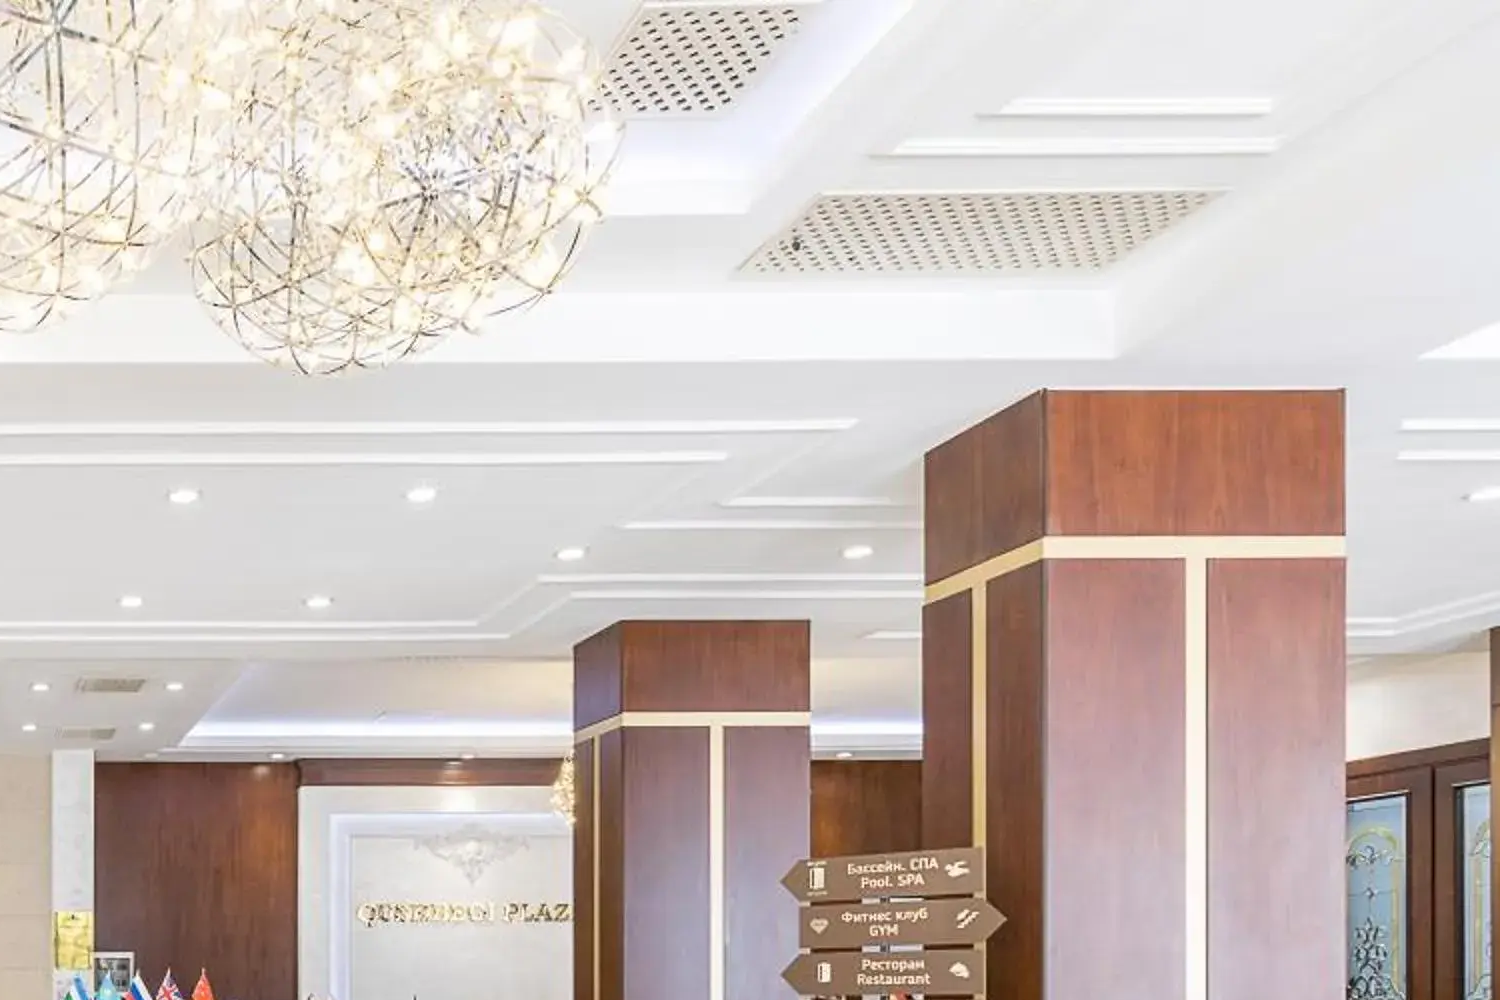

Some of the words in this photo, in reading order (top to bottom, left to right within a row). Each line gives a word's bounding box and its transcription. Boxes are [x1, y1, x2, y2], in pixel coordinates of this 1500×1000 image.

[909, 857, 939, 871] СПА
[897, 873, 925, 887] SPA
[503, 903, 572, 923] PLAZ
[841, 911, 892, 923] Фитнес
[895, 907, 929, 923] клуб
[869, 924, 899, 936] GYM
[861, 959, 925, 973] Ресторан
[856, 973, 932, 986] Restaurant
